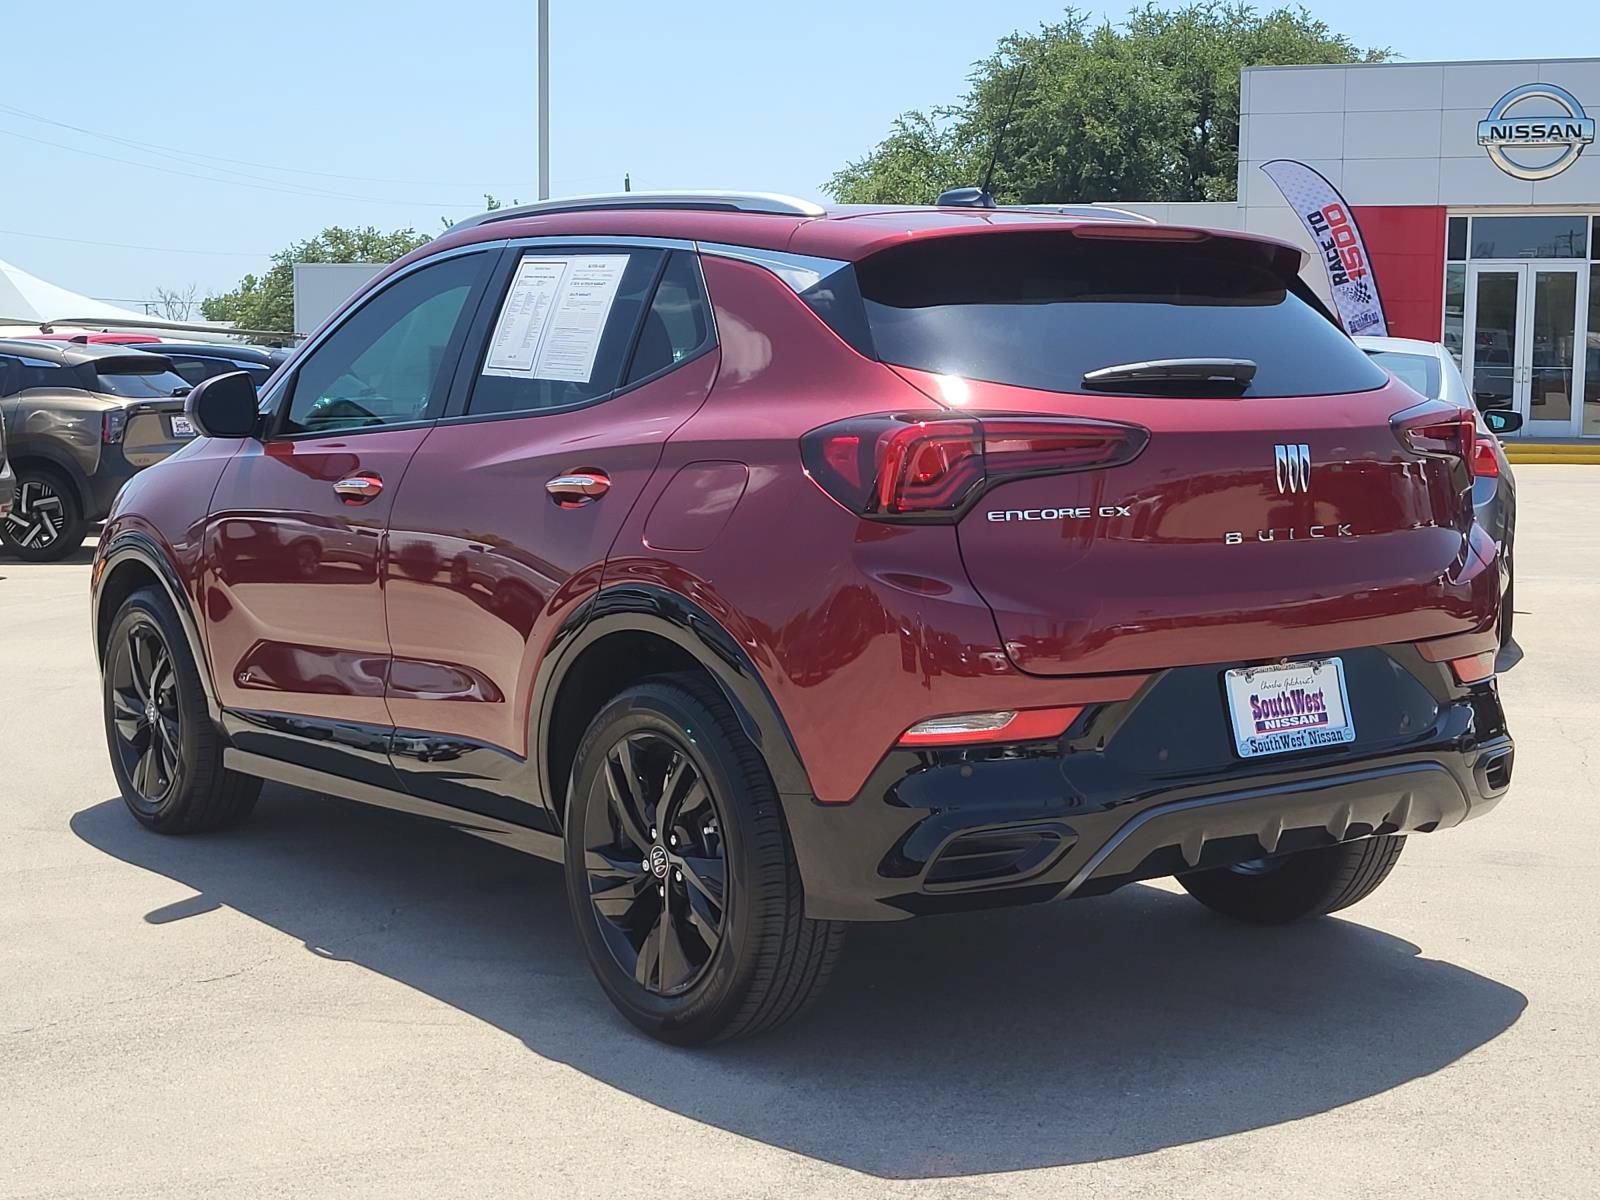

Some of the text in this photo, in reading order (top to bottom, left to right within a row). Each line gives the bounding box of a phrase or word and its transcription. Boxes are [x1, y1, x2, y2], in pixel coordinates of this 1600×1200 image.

[1490, 124, 1582, 139] NISSAN
[1307, 210, 1350, 286] RACE TO
[1322, 203, 1367, 282] 1500
[987, 505, 1132, 522] ENCORE GX
[1225, 523, 1352, 545] BUICK
[1250, 687, 1326, 720] SouthWest
[1264, 714, 1320, 730] NISSAN
[1250, 730, 1344, 753] SouthWest Nissan
